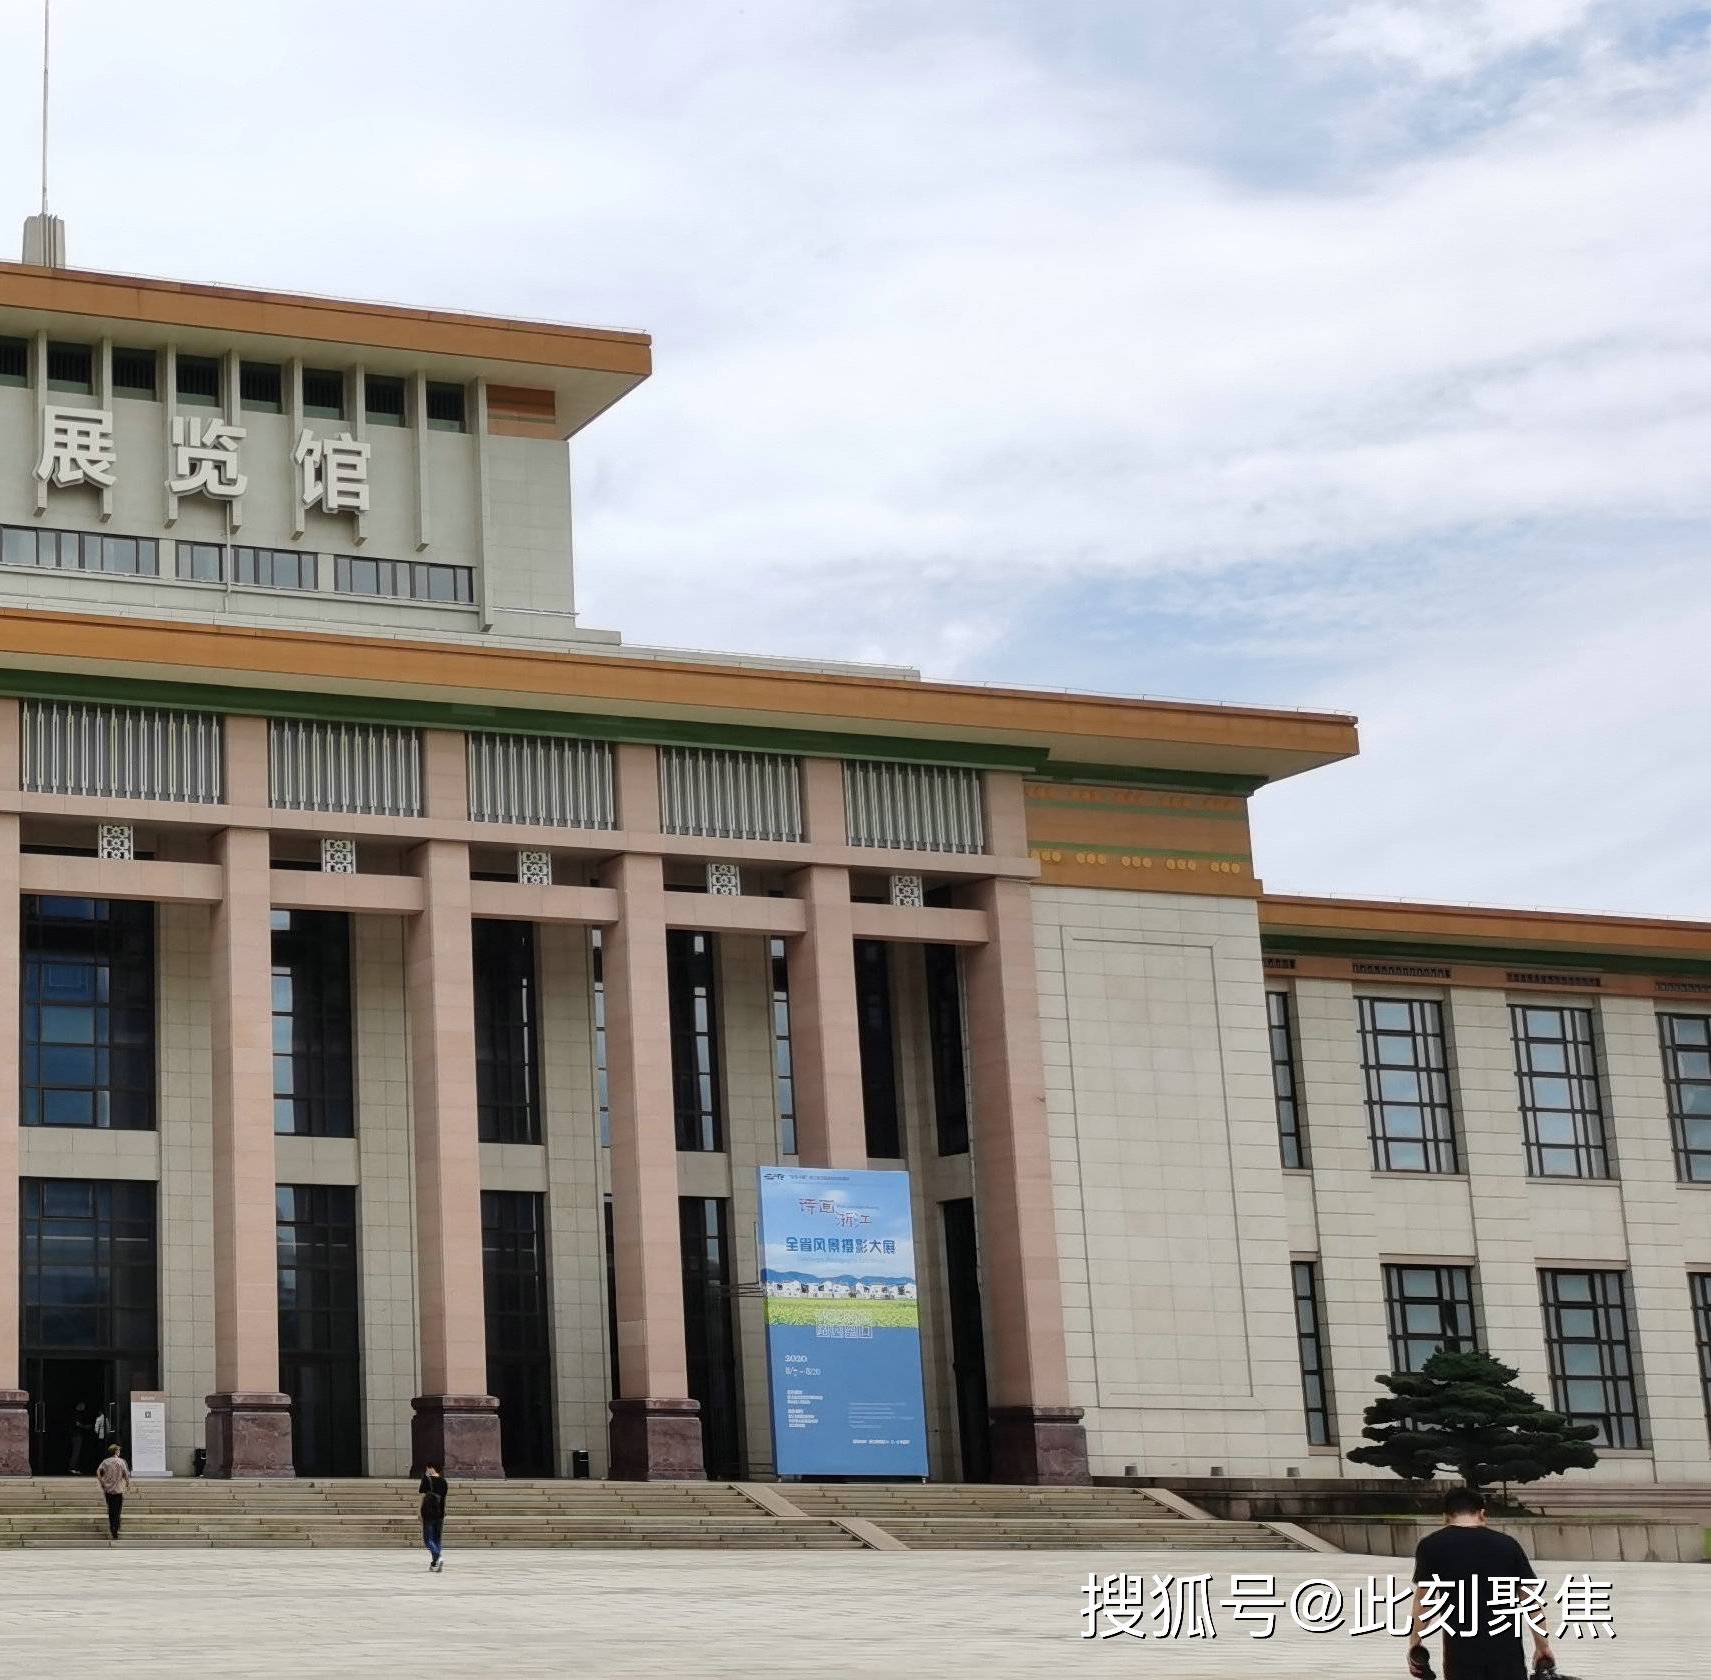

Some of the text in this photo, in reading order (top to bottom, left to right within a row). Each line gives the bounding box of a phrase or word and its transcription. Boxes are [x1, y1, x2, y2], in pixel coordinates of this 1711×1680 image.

[785, 1236, 897, 1255] 全省风景摄影大展
